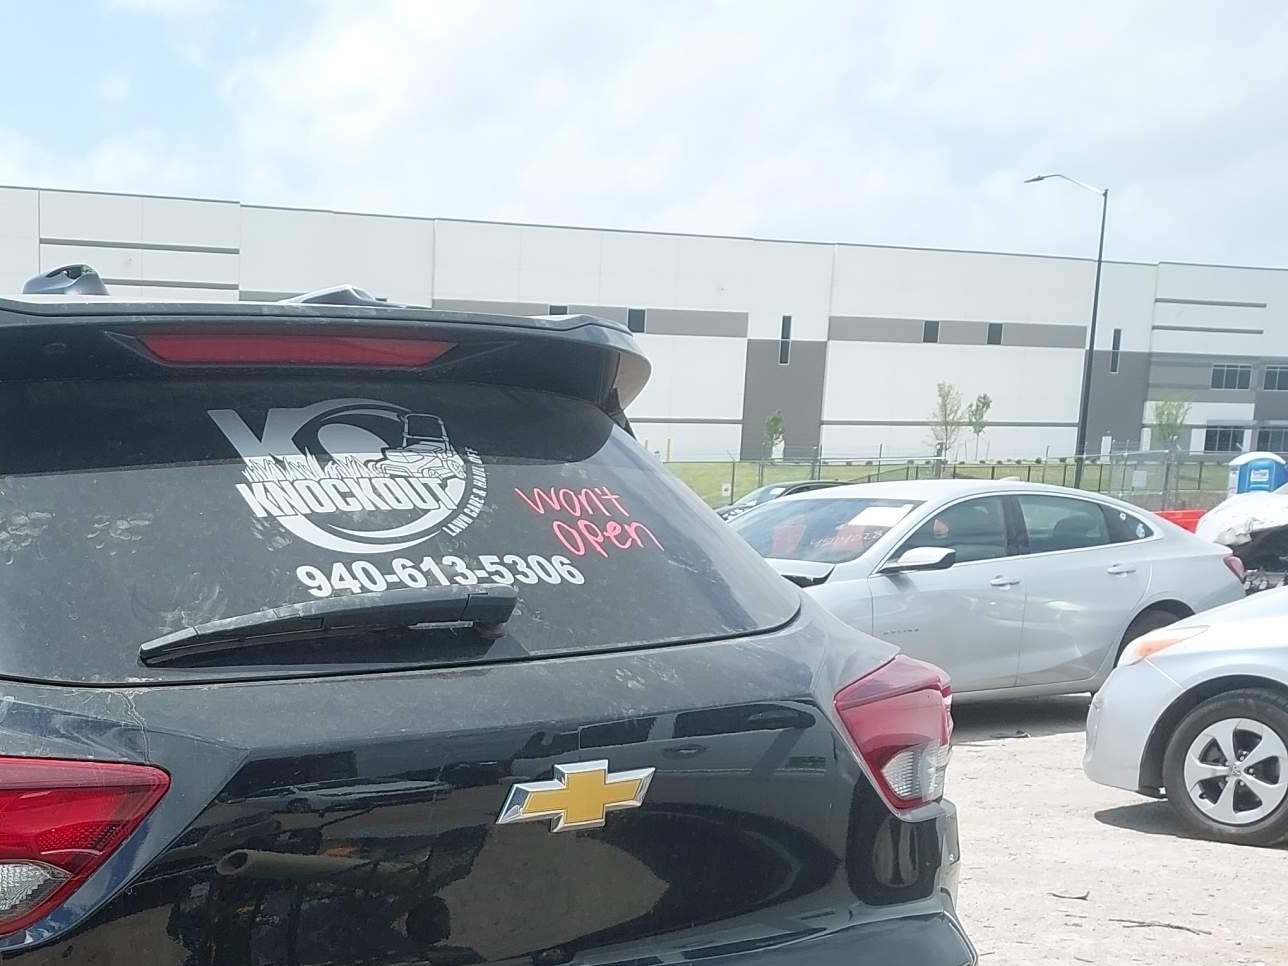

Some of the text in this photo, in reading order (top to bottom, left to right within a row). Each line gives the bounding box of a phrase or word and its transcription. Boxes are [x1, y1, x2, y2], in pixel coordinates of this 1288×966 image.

[472, 464, 487, 489] HAUL
[235, 477, 458, 518] KNOCKOUT
[463, 494, 485, 518] CARE
[442, 513, 473, 537] LAWN
[296, 555, 585, 598] 940-613-5306
